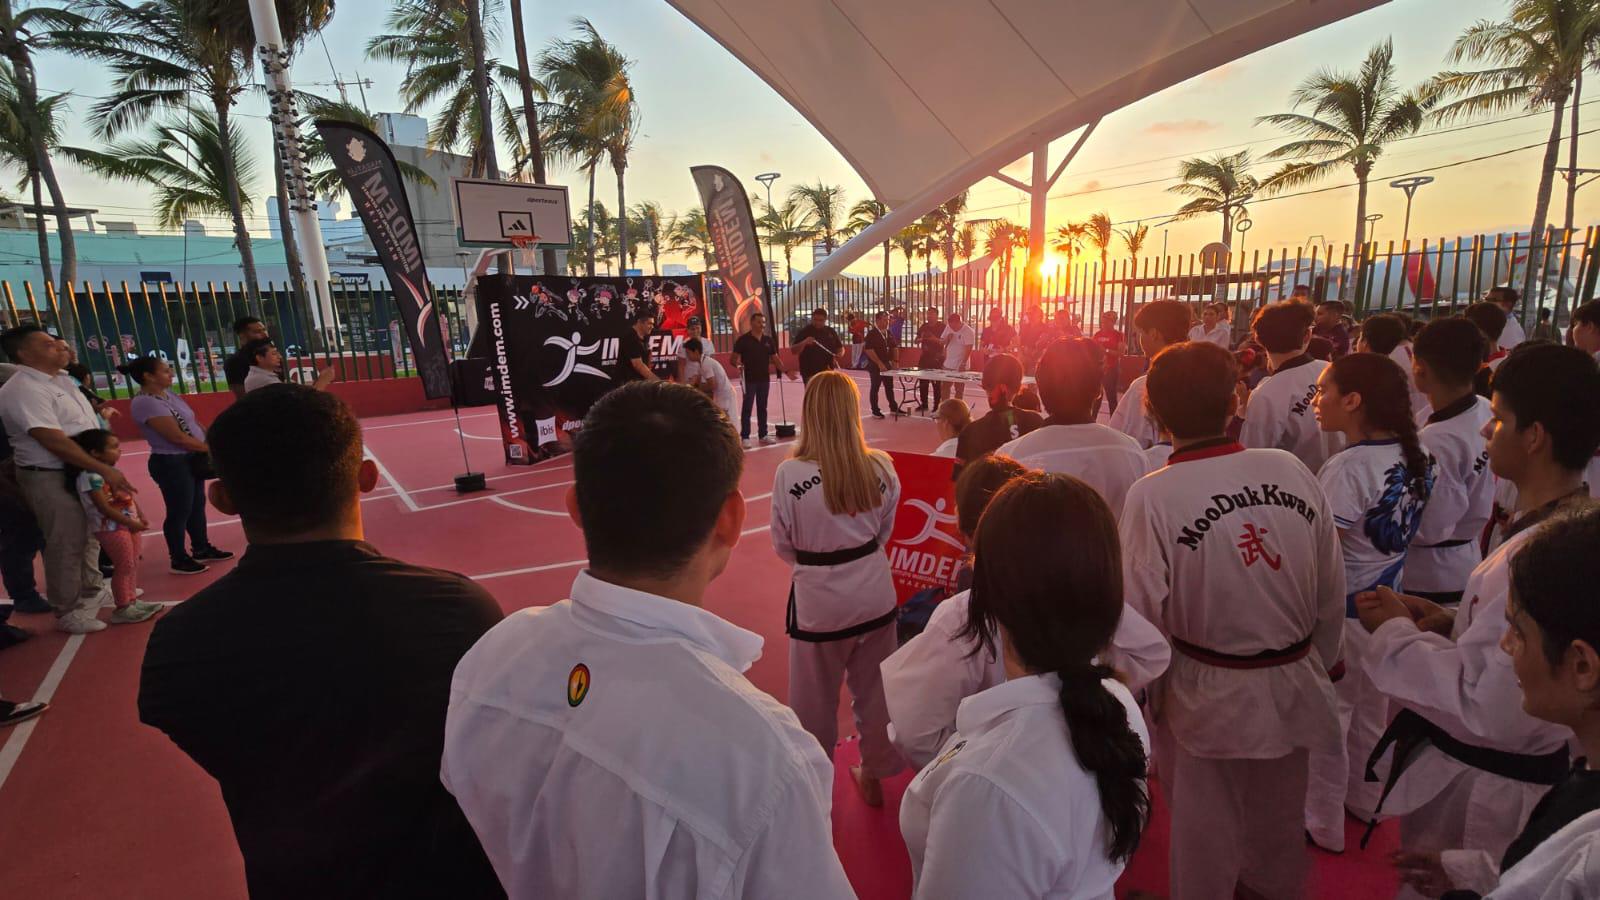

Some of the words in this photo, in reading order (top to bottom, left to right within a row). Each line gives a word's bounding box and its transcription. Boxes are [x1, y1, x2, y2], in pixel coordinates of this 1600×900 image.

[490, 302, 519, 438] www.imdem.com
[789, 469, 822, 500] Moo
[1237, 523, 1281, 571] 武
